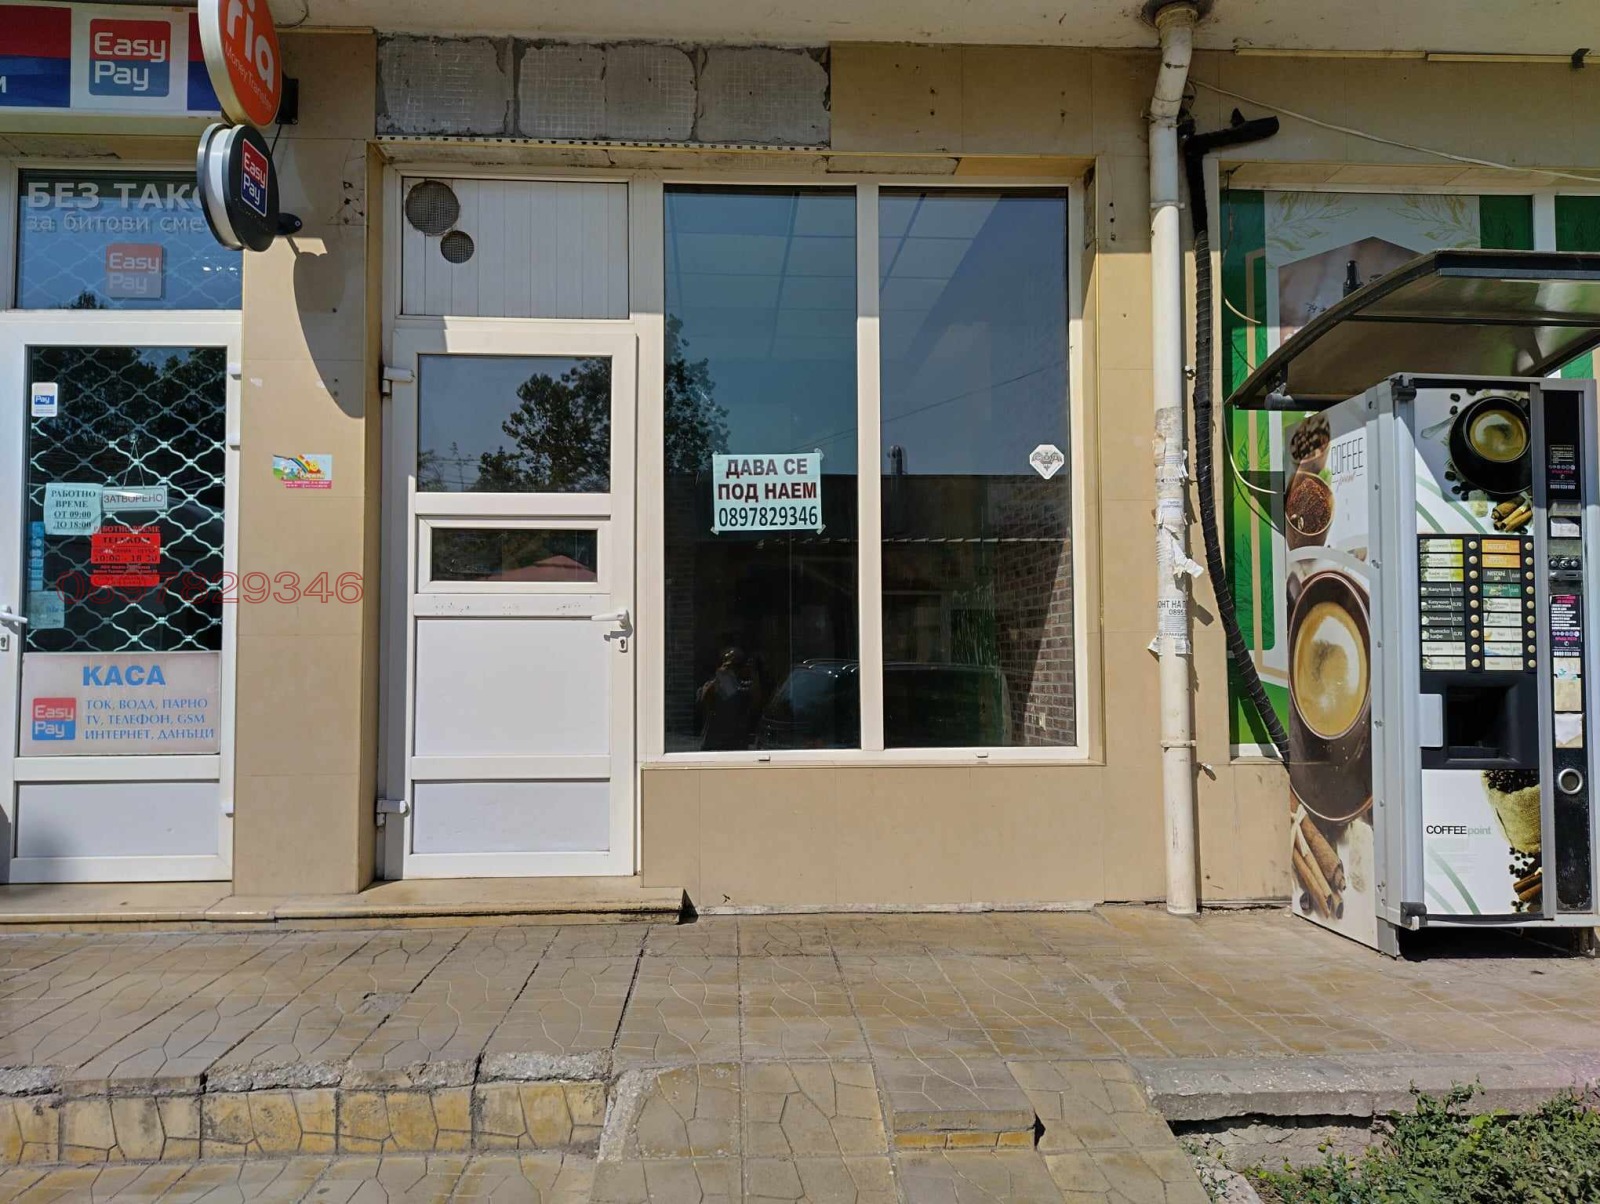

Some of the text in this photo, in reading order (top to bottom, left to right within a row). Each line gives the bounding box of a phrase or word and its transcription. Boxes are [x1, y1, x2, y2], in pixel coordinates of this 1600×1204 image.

[94, 32, 166, 63] Easy
[226, 0, 275, 94] ria
[94, 61, 149, 91] Pay
[243, 152, 267, 188] Easy
[27, 182, 99, 209] БЕЗ
[243, 173, 261, 206] Pay
[27, 212, 203, 232] за битови сме
[108, 252, 162, 274] Easy
[108, 274, 148, 294] Pay
[1331, 436, 1364, 475] COFFEE
[726, 458, 808, 479] ДАВА СЕ
[51, 490, 96, 498] РАБОТНО
[103, 493, 163, 504] ЗАТВОРЕНО
[718, 482, 817, 503] ПОД НАЕМ
[52, 521, 92, 529] ДО 18:00
[53, 511, 92, 519] ОТ 09:00
[719, 506, 819, 527] 0897829346
[1168, 608, 1187, 616] 0895
[82, 665, 167, 687] КАСА
[34, 704, 75, 719] Easy
[87, 698, 208, 711] ТОК, ВОДА, ПАРНО
[34, 721, 65, 737] Pay
[86, 714, 205, 726] TV, ТЕЛЕФОН, GSM
[84, 728, 215, 740] ИНТЕРНЕТ, ДАНЪЦИ
[1426, 825, 1468, 835] COFFEE
